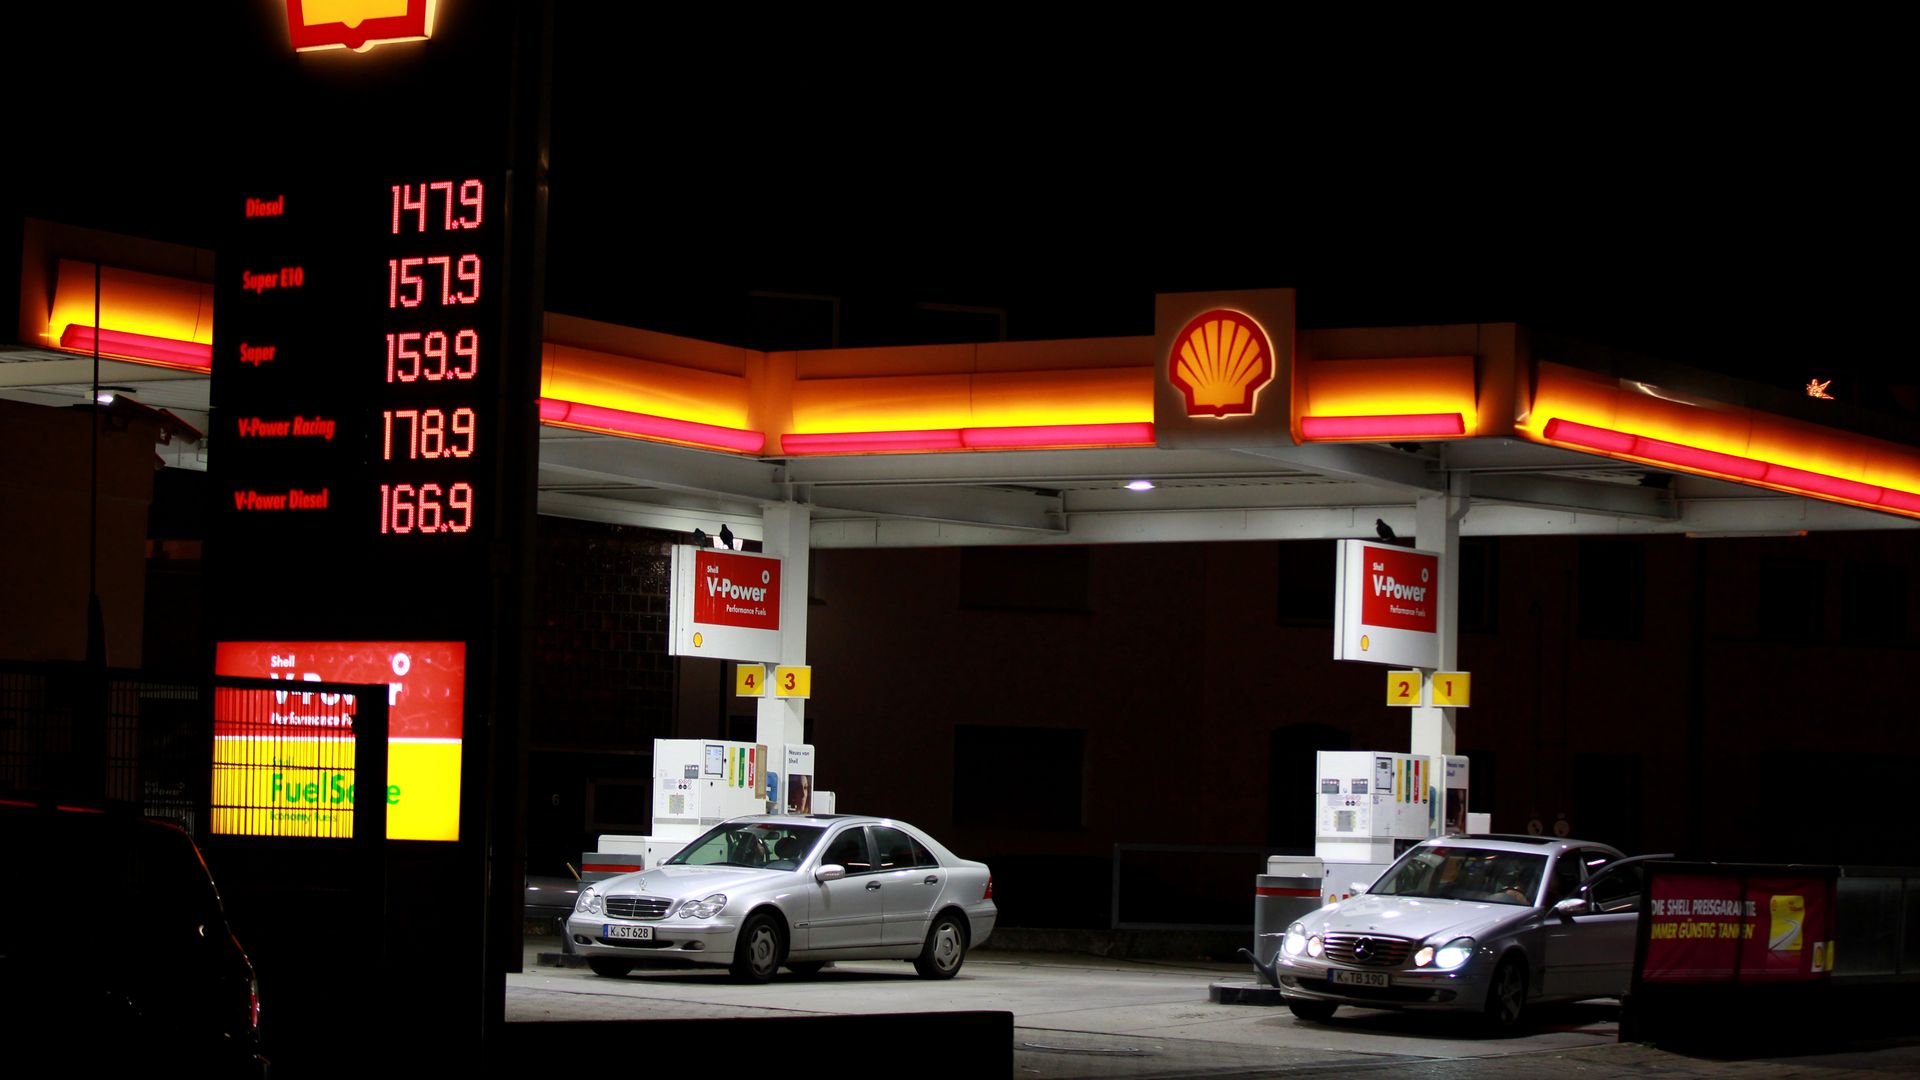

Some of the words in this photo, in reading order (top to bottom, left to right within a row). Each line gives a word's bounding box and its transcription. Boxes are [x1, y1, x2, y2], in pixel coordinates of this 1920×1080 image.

[246, 195, 284, 218] Diesel
[243, 270, 277, 294] Super
[280, 266, 304, 287] E10
[240, 342, 276, 367] Super
[238, 416, 290, 438] V-Power
[292, 415, 336, 441] Racing
[234, 490, 286, 510] V-Power
[289, 487, 328, 509] Diesel
[707, 565, 719, 574] Shell
[707, 576, 767, 602] V-Power
[1373, 574, 1426, 602] V-Power
[726, 604, 754, 616] Performance
[755, 608, 767, 616] Fuels
[271, 655, 296, 668] Shell
[270, 673, 403, 706] V-Por
[744, 673, 755, 689] 4
[784, 672, 796, 691] 3
[1398, 681, 1410, 698] 2
[1445, 681, 1452, 697] 1
[271, 771, 401, 805] FuelSe
[1650, 899, 1665, 916] DIE
[1666, 898, 1691, 916] SHELL
[610, 926, 617, 937] K
[620, 926, 632, 937] ST
[632, 927, 649, 938] 628
[1678, 918, 1717, 939] GÜNSTIG
[1336, 971, 1344, 982] K
[1350, 971, 1363, 983] TB
[1366, 973, 1384, 985] 190
